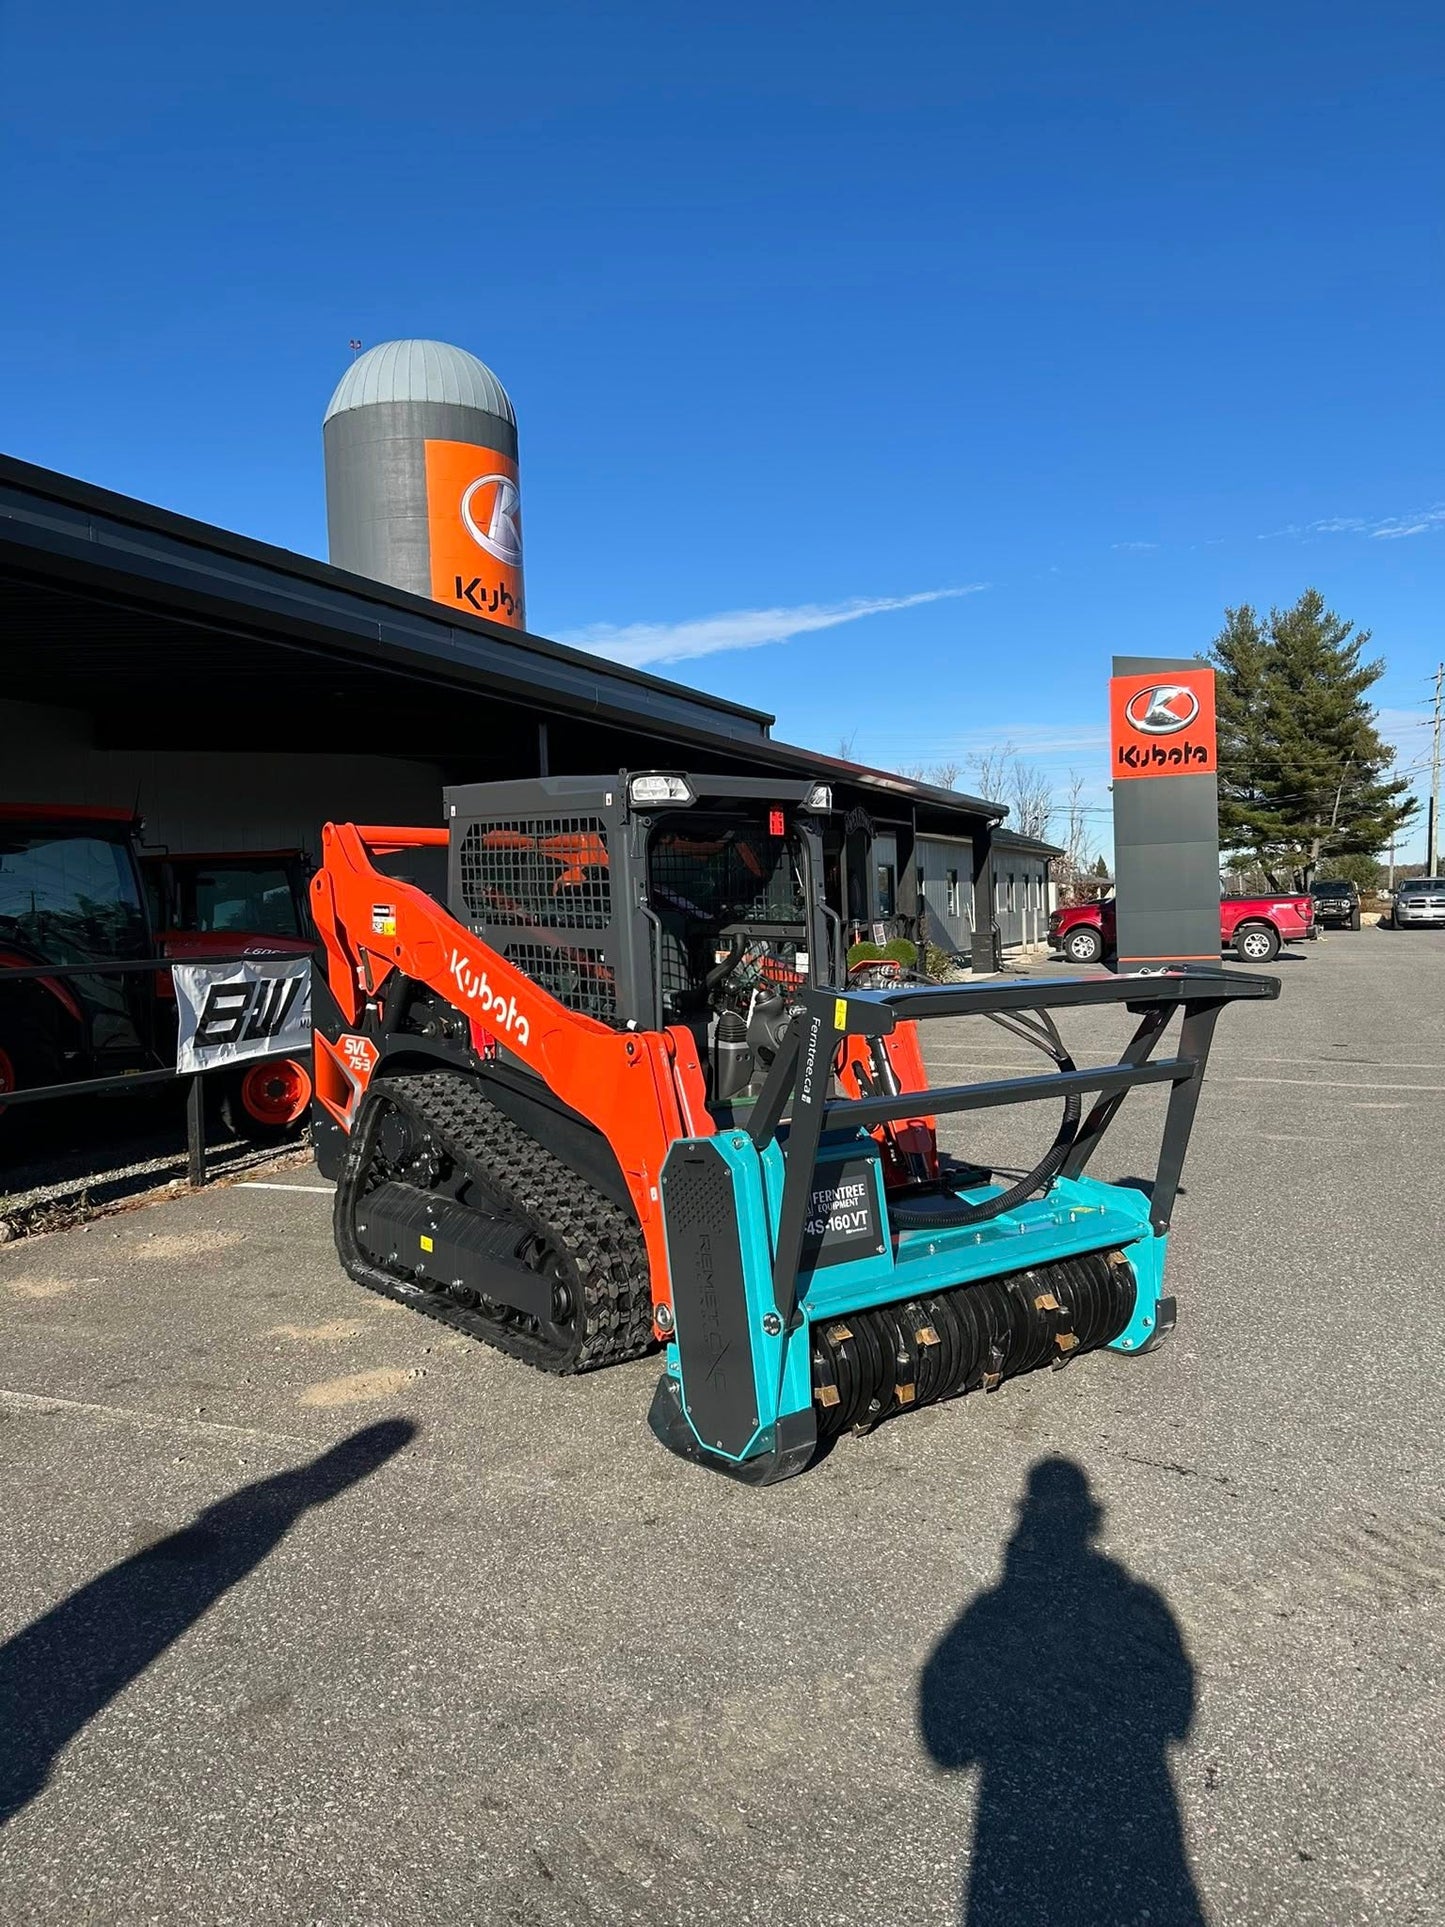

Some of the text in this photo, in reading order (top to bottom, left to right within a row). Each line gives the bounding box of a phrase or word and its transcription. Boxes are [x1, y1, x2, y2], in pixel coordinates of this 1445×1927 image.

[1119, 741, 1208, 768] Kubota
[450, 948, 530, 1047] Kubota
[344, 1038, 369, 1058] SVL
[803, 1016, 821, 1094] Ferntree.ca
[812, 1183, 866, 1205] FERNTREE
[817, 1197, 859, 1215] EQUIPMENT
